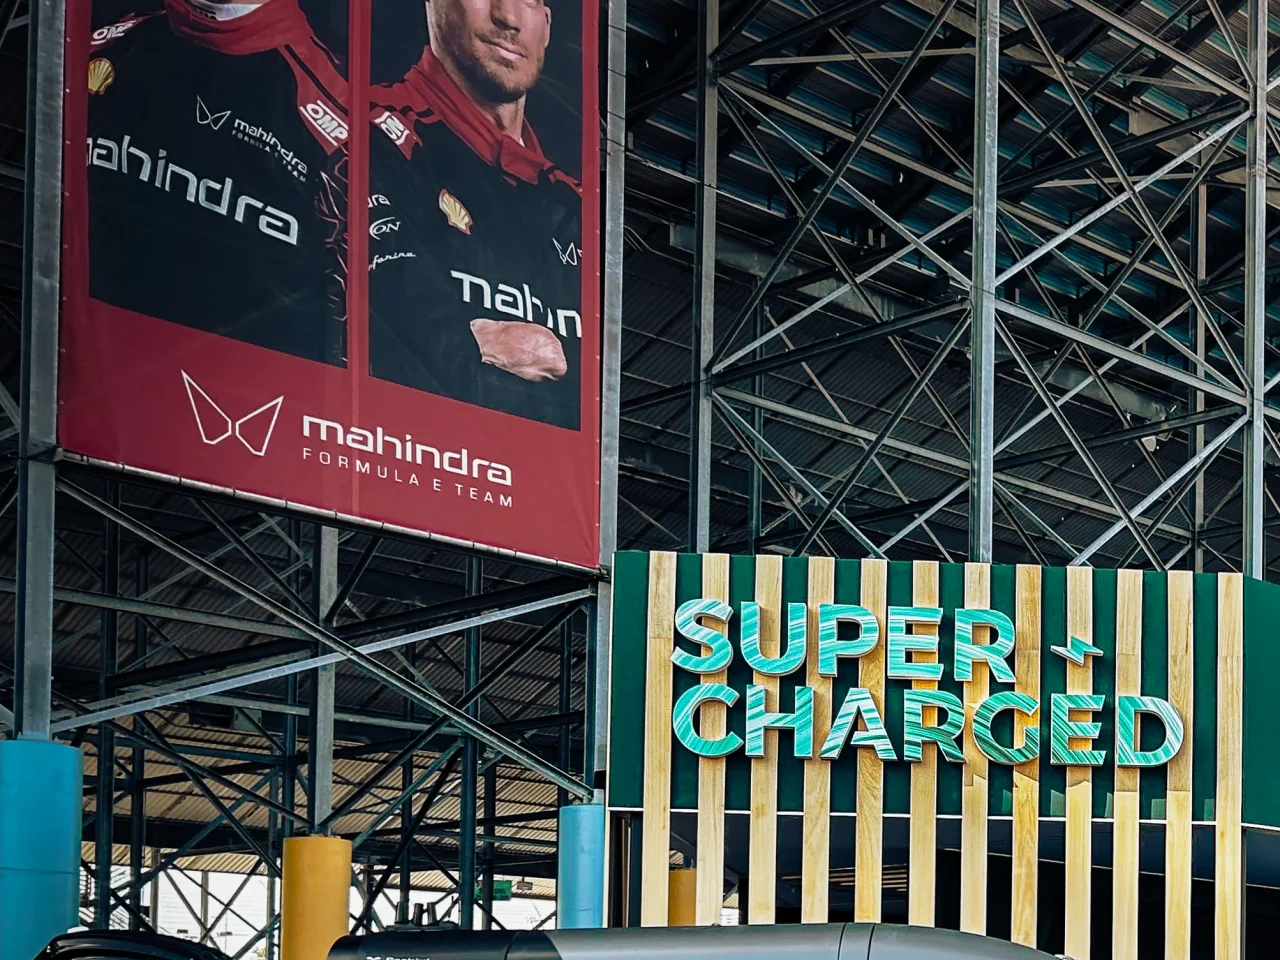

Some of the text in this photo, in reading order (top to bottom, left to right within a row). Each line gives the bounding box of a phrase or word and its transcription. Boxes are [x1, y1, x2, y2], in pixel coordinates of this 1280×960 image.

[234, 119, 308, 174] mahindra
[306, 103, 348, 142] OMP
[86, 135, 299, 246] ahindra
[303, 415, 513, 487] mahindra
[303, 447, 513, 508] FORMULA E TEAM
[670, 598, 1017, 684] SUPER
[671, 682, 1185, 768] CHARGED
